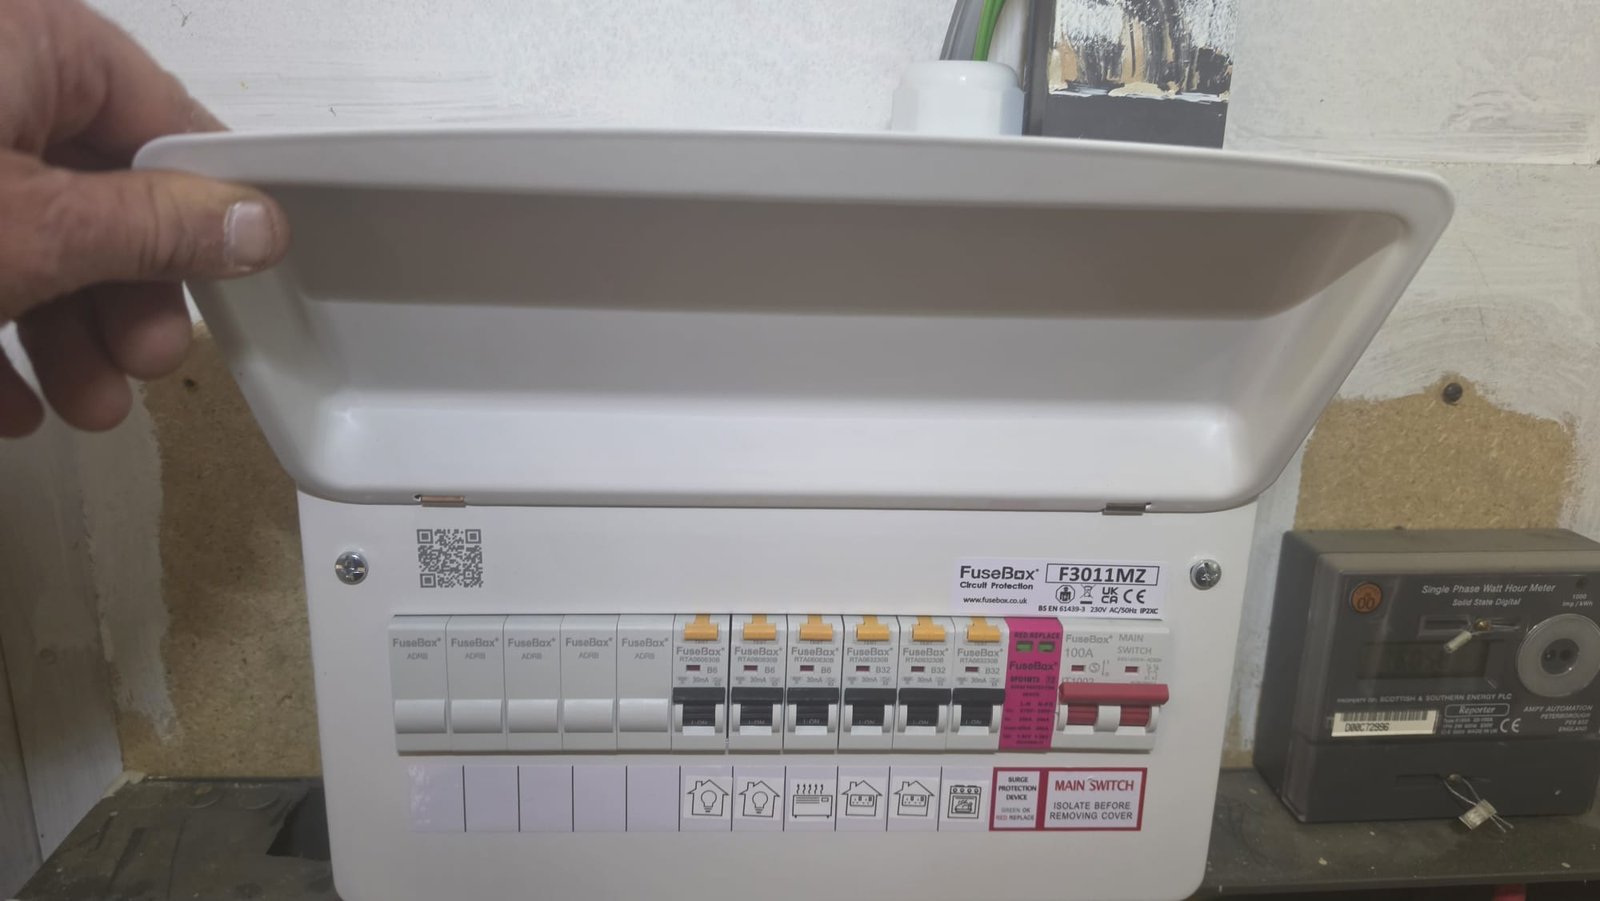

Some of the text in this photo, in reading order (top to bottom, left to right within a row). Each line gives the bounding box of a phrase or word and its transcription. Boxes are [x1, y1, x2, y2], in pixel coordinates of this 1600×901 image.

[960, 565, 1040, 580] FuseBox
[1059, 566, 1146, 584] F3011MZ
[960, 581, 1034, 590] Circuit Protection
[1421, 584, 1556, 594] Single Phase Watt Hour Meter
[963, 596, 1028, 604] www.fusebox.co.uk
[1452, 598, 1522, 607] Solid State Digital
[1090, 606, 1108, 614] 230V
[1109, 606, 1137, 614] AC/50Hz
[566, 637, 614, 648] FuseBox
[1066, 634, 1112, 644] FuseBox
[1119, 634, 1144, 642] MAIN
[393, 638, 442, 648] FuseBox
[451, 638, 500, 648] FuseBox
[508, 638, 556, 648] FuseBox
[622, 638, 670, 648] FuseBox
[676, 646, 725, 656] FuseBox
[735, 646, 782, 656] FuseBox
[791, 646, 839, 656] FuseBox
[847, 647, 894, 656] FuseBox
[903, 648, 949, 657] FuseBox
[957, 648, 1004, 657] FuseBox
[1066, 648, 1094, 658] 100A
[1118, 646, 1152, 655] SWITCH
[707, 666, 718, 674] B6
[764, 666, 776, 674] B6
[821, 666, 832, 674] B6
[876, 666, 891, 674] B32
[931, 666, 946, 674] B32
[1379, 695, 1416, 703] SCOTTISH
[1425, 694, 1465, 702] SOUTHERN
[1459, 704, 1496, 714] Reporter
[1546, 704, 1594, 712] AUTOMATION
[1055, 779, 1134, 792] MAIN SWITCH
[1053, 802, 1131, 810] ISOLATE BEFORE
[1050, 811, 1133, 820] REMOVING COVER
